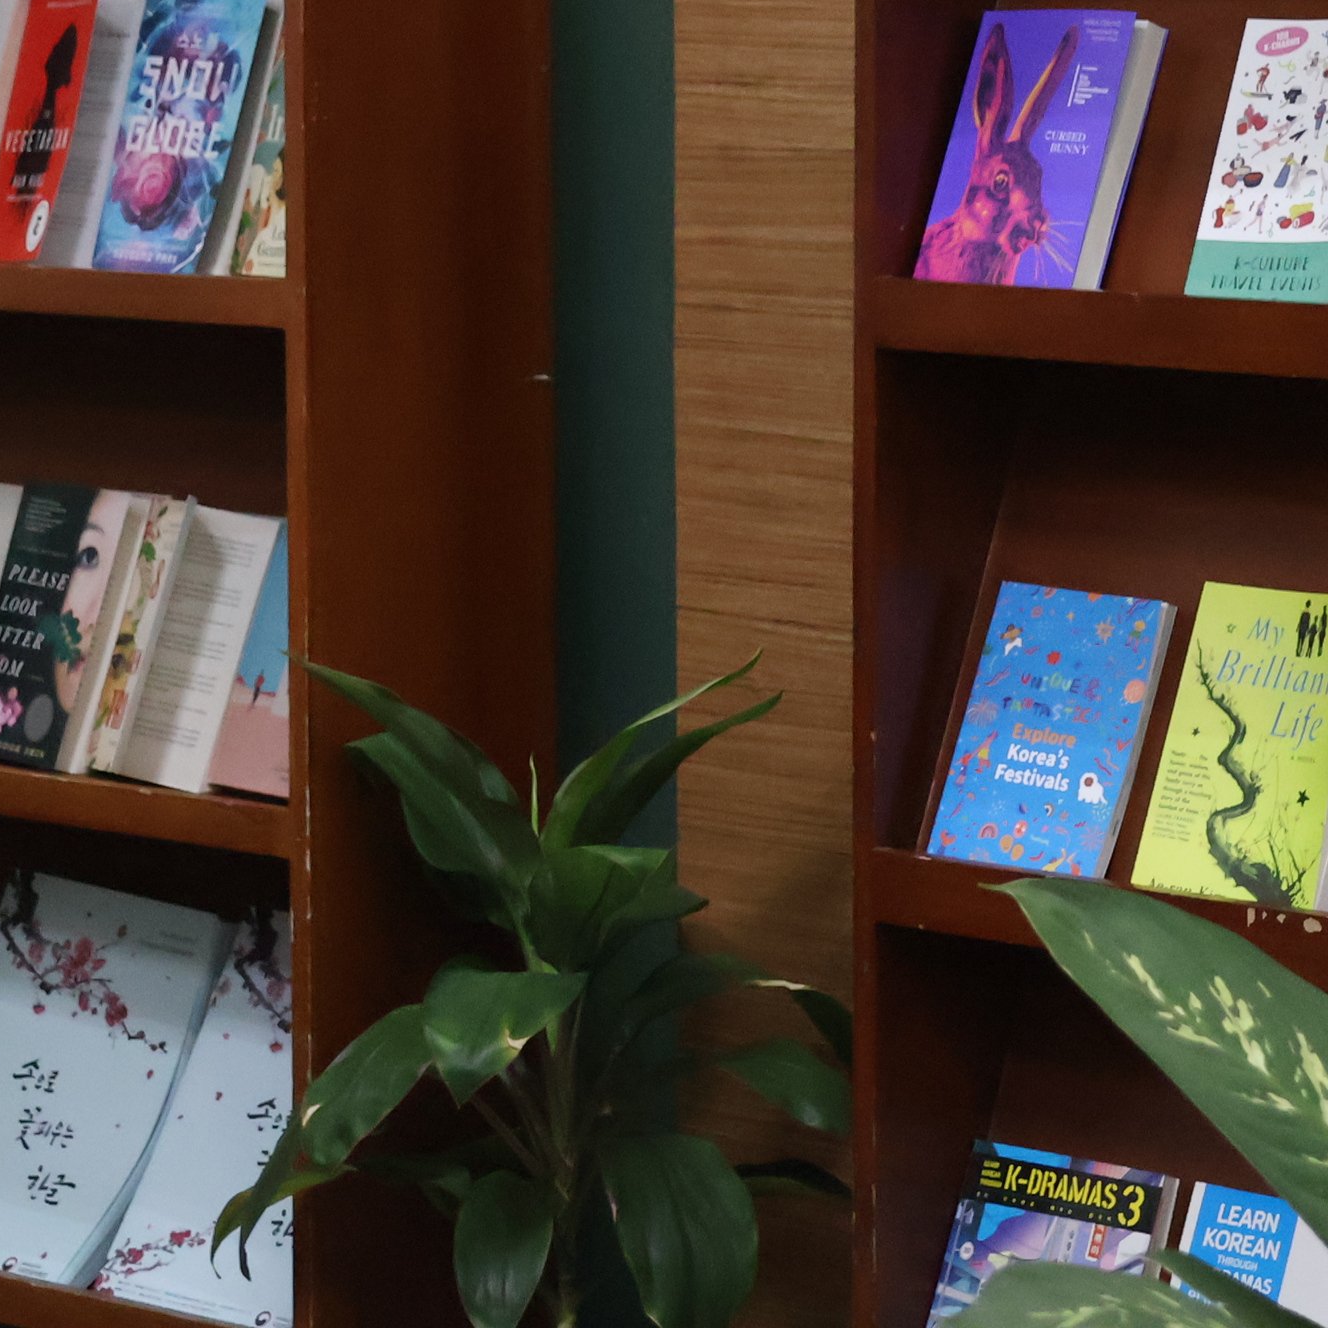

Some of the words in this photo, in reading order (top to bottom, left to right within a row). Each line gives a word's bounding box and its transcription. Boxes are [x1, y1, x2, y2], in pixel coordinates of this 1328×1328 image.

[138, 54, 239, 103] SNOW
[125, 113, 225, 160] GLOBE
[8, 563, 70, 592] PLEASE
[0, 594, 43, 618] LOOK
[1246, 617, 1286, 650] My
[1011, 722, 1077, 748] Explore
[1270, 700, 1324, 751] Life
[994, 763, 1070, 793] Festivals
[1003, 1164, 1119, 1210] K-DRAMAS
[1118, 1184, 1146, 1228] 3
[1217, 1202, 1281, 1234] LEARN
[1202, 1227, 1282, 1261] KOREAN
[1217, 1253, 1258, 1272] THROUGH
